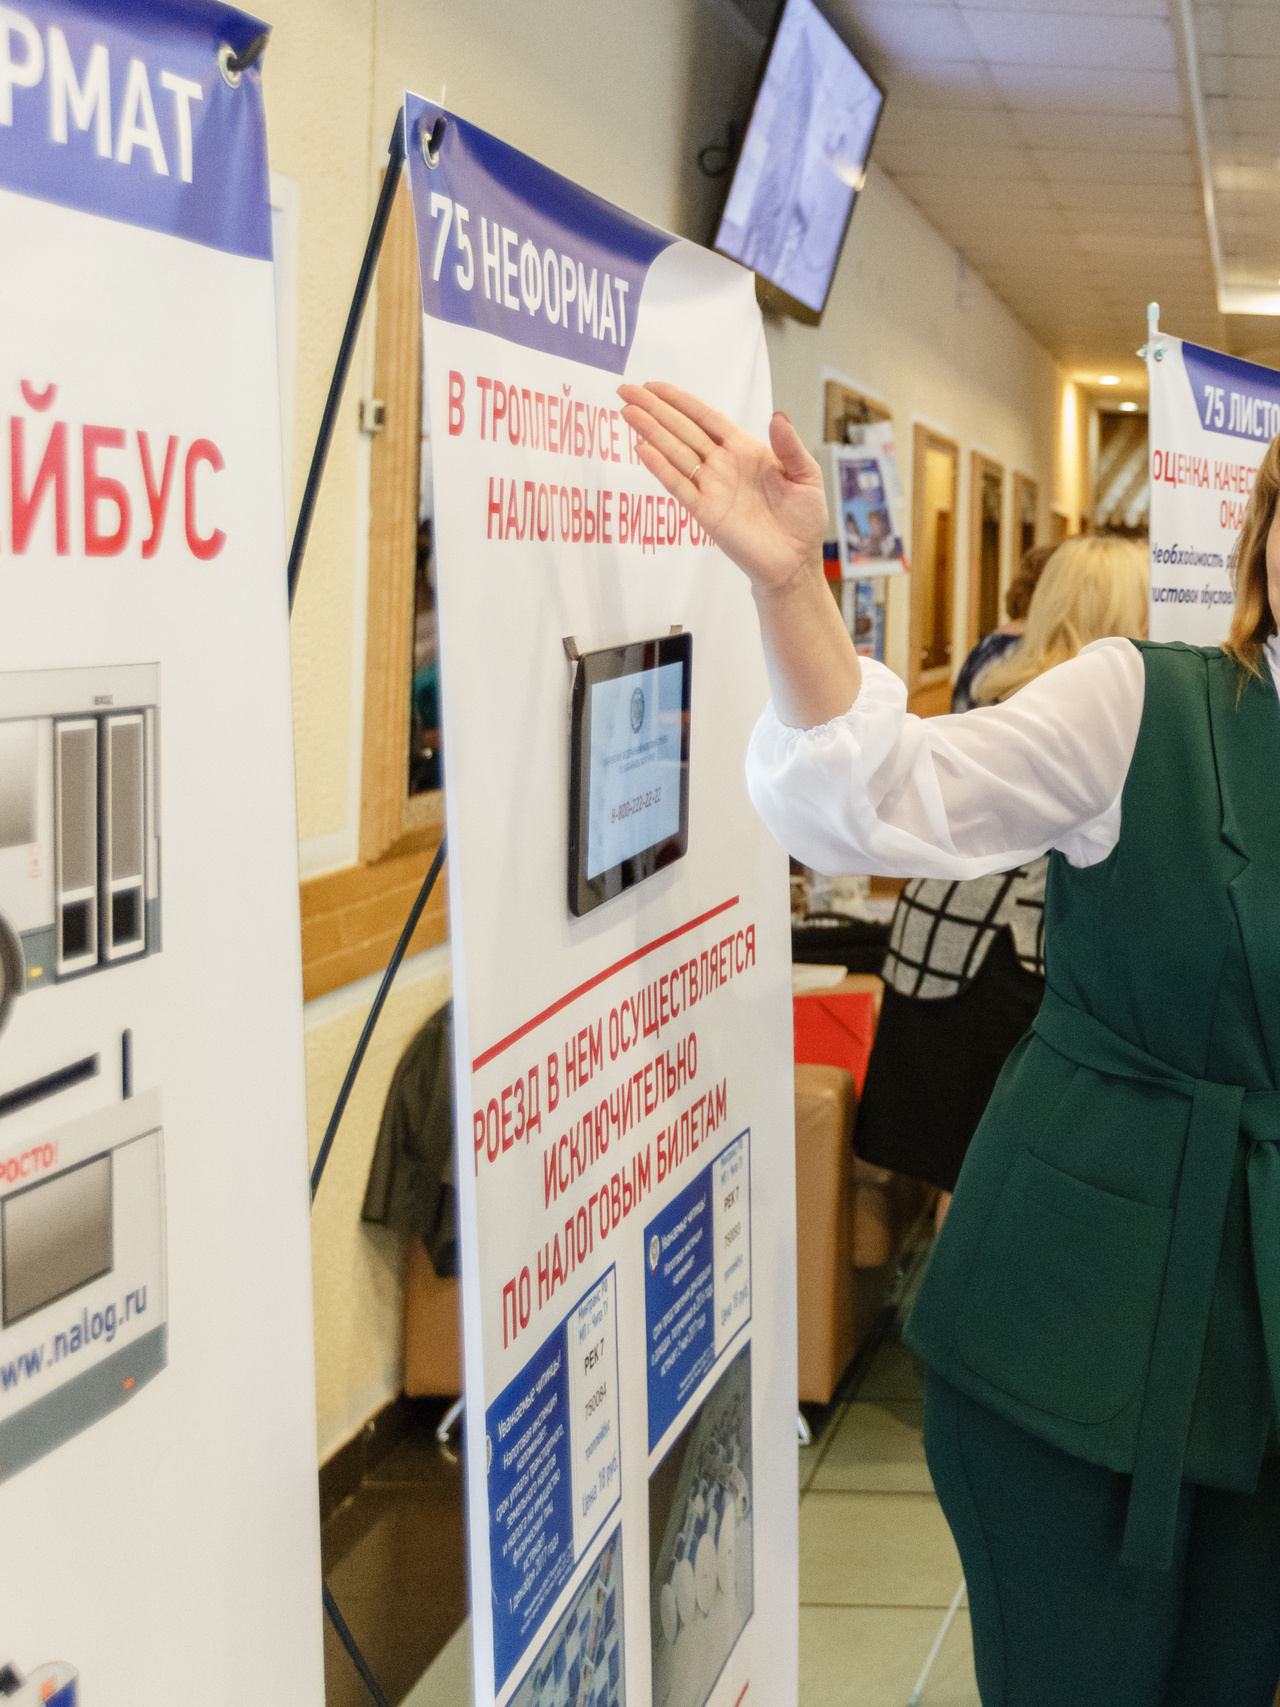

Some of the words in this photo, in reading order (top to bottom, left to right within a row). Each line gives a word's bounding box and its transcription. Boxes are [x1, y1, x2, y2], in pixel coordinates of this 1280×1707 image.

[428, 191, 475, 291] 75
[481, 216, 629, 348] НЕФОРМАТ
[448, 370, 466, 437] В
[476, 376, 621, 463] ТРОЛЛЕЙБУСЕ
[1204, 385, 1225, 428] 75
[0, 378, 228, 561] ЙБУС
[1153, 449, 1210, 489] ОЦЕНКА
[487, 476, 613, 544] НАЛОГОВЫЕ
[618, 492, 716, 555] ВИДЕОРО
[611, 786, 662, 824] 8-800-222-22-22
[547, 1052, 560, 1114] В
[564, 1017, 604, 1099] НЕМ
[608, 923, 756, 1062] ОСУЩЕСТВЛЯЕТСЯ
[543, 1031, 697, 1211] ИСКЛЮЧИТЕЛЬНО
[502, 1264, 531, 1350] ПО
[537, 1143, 651, 1312] НАЛОГОВЫМ
[656, 1077, 727, 1185] БИЛЕТАМ
[584, 1344, 599, 1376] РЕК
[600, 1337, 605, 1356] 7
[497, 1387, 535, 1443] Уважаемые
